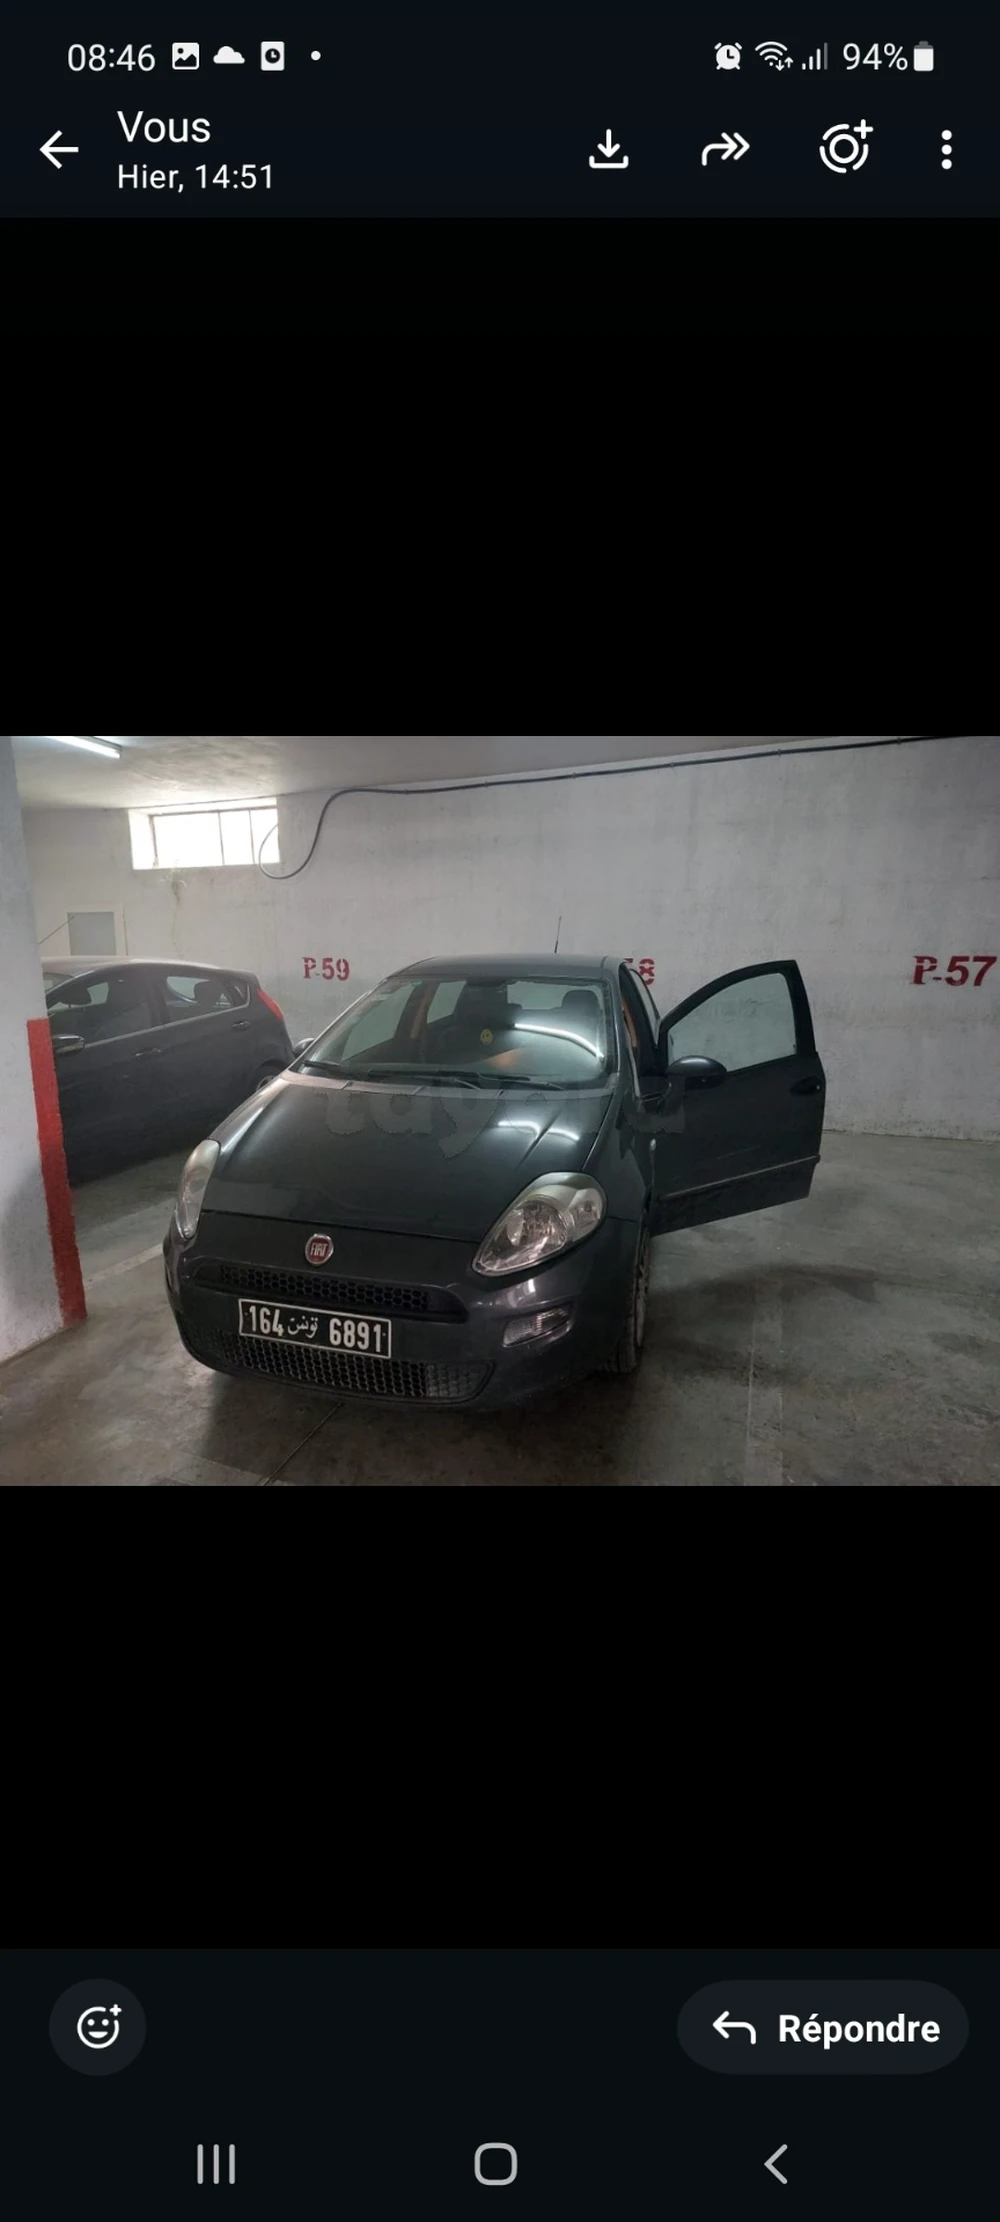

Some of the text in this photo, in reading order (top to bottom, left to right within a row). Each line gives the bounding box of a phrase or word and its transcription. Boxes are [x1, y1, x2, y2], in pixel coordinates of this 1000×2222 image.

[302, 956, 350, 981] P-59
[624, 958, 655, 985] 8
[910, 955, 998, 987] P-57
[309, 1242, 328, 1257] FIAT
[249, 1305, 382, 1353] 164 تونس 6891
